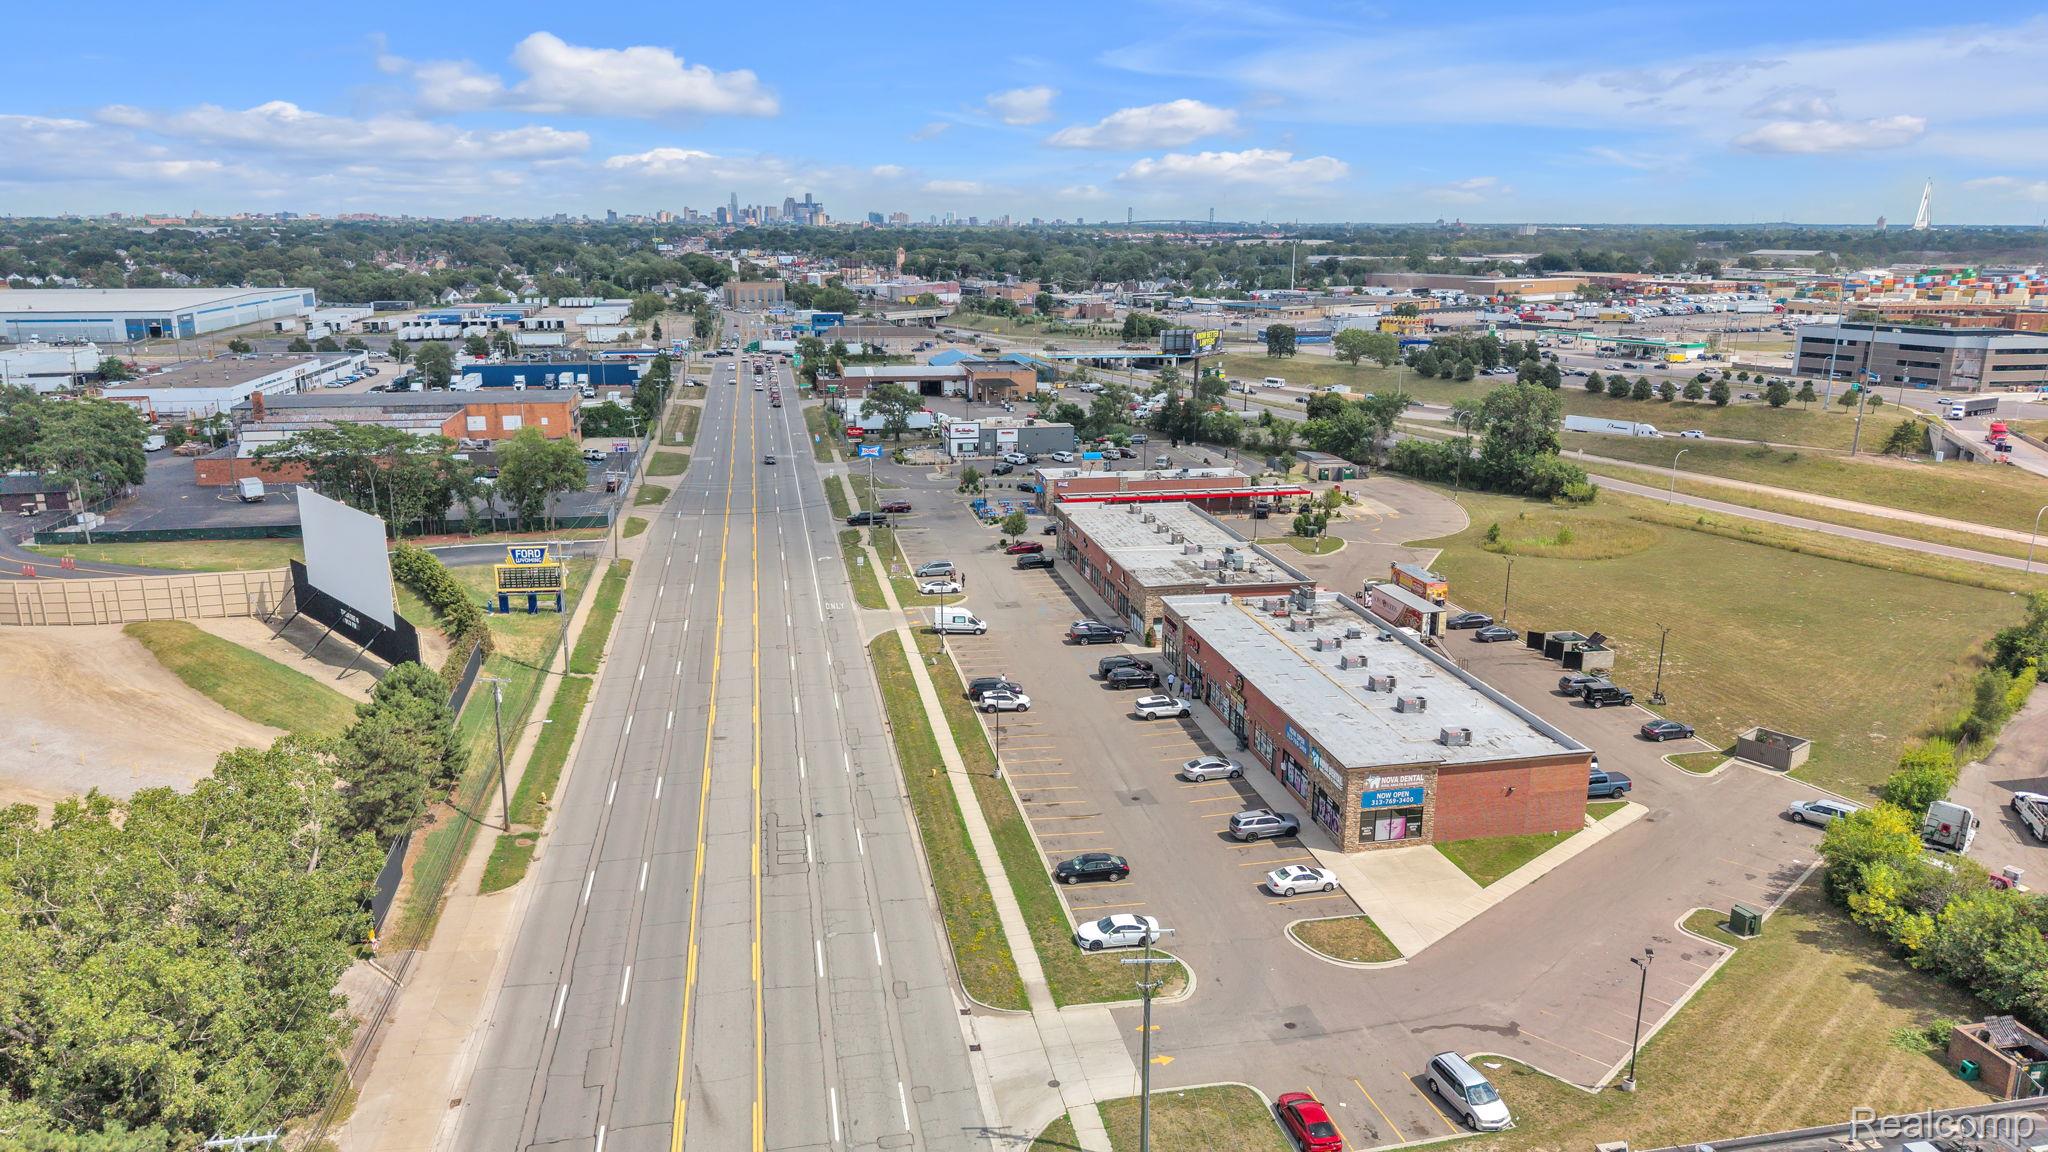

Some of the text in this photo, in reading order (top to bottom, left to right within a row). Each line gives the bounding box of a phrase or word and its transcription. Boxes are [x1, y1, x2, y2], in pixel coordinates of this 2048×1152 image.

[515, 549, 541, 557] FORD
[825, 602, 844, 610] ONLY
[1381, 774, 1424, 784] NOVA DENTAL
[1371, 797, 1414, 806] 313-769-3400
